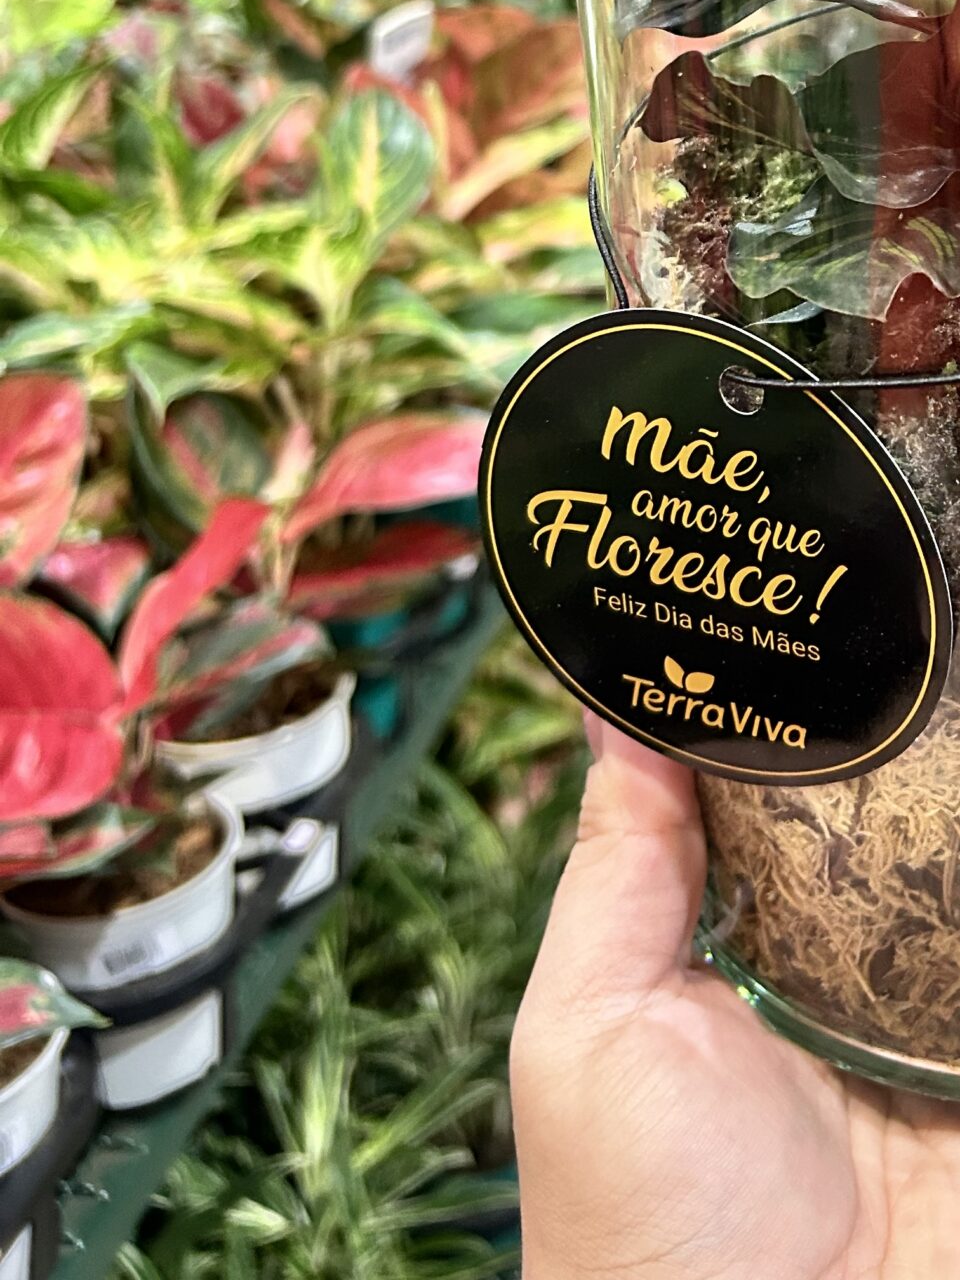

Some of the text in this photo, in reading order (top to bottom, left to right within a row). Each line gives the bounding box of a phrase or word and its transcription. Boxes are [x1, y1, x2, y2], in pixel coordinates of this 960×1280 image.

[631, 489, 825, 562] amor que
[593, 586, 821, 661] Feliz Dia das Mães
